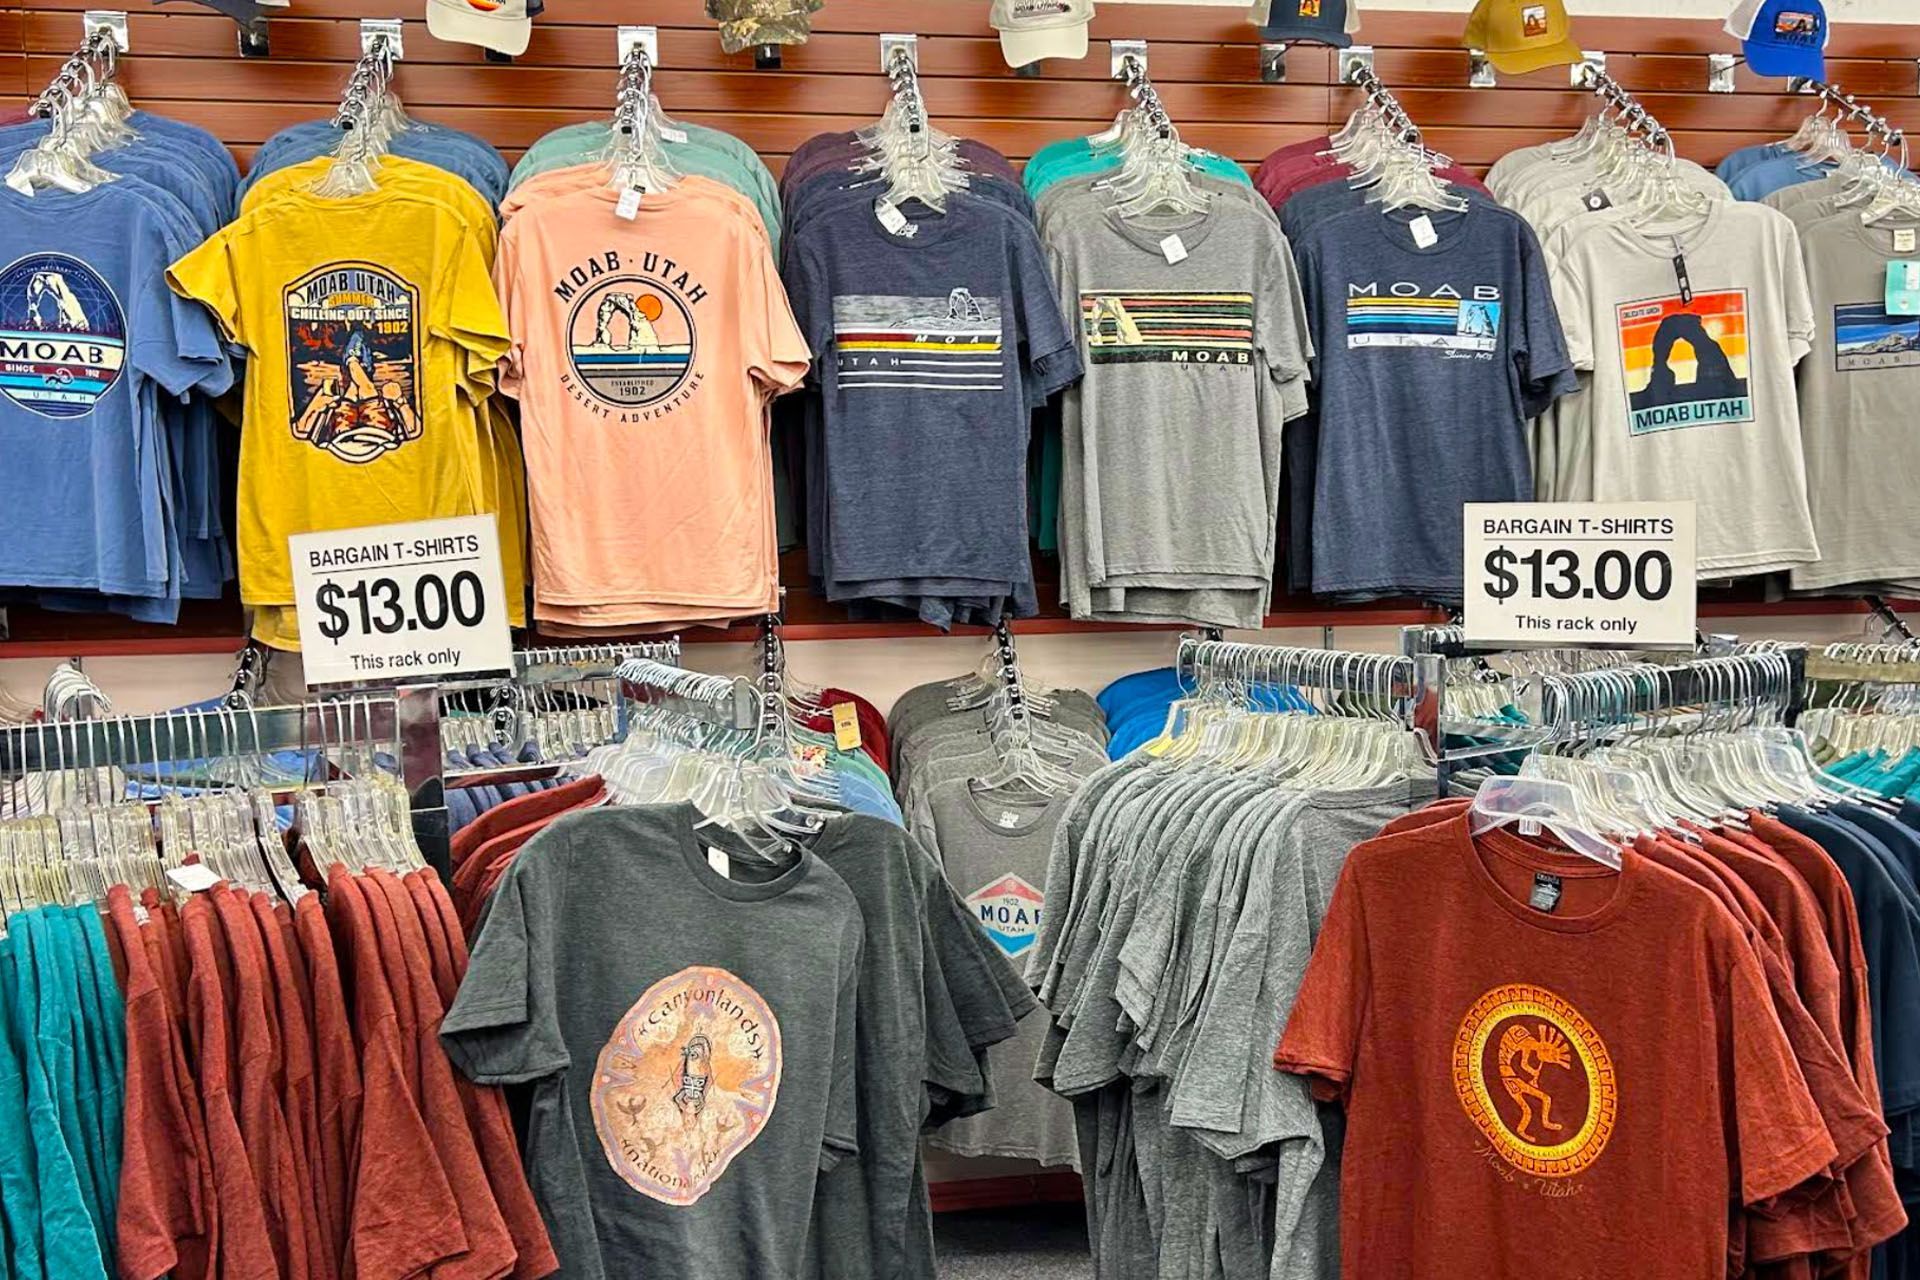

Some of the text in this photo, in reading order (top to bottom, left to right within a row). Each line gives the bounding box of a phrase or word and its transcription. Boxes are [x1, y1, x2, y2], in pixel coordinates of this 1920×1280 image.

[554, 251, 708, 305] MOAB UTAH
[306, 273, 396, 303] MOAB UTAH
[1348, 282, 1500, 300] MOAB
[328, 293, 375, 308] SUMMER
[291, 308, 409, 321] CHILLING OUT SINCE
[377, 321, 408, 334] 1902
[1352, 336, 1493, 349] UTAH
[0, 342, 104, 364] MOAB
[838, 357, 900, 366] UTAH
[1172, 351, 1249, 363] MOAB
[5, 363, 35, 374] SINCE
[1181, 364, 1248, 373] UTAH
[560, 372, 705, 424] DESERT ADVENTURE
[620, 386, 646, 397] 1902
[1636, 400, 1744, 429] MOAB UTAH
[1483, 518, 1674, 534] BARGAIN T-SHIRTS
[309, 535, 479, 567] BARGAIN T-SHIRTS
[1483, 545, 1673, 605] $13.00
[316, 570, 486, 645] $13.00
[1515, 615, 1638, 635] This rack only
[350, 648, 461, 671] This rack only
[648, 989, 760, 1046] Canyonlands
[1534, 1179, 1578, 1197] Utah
